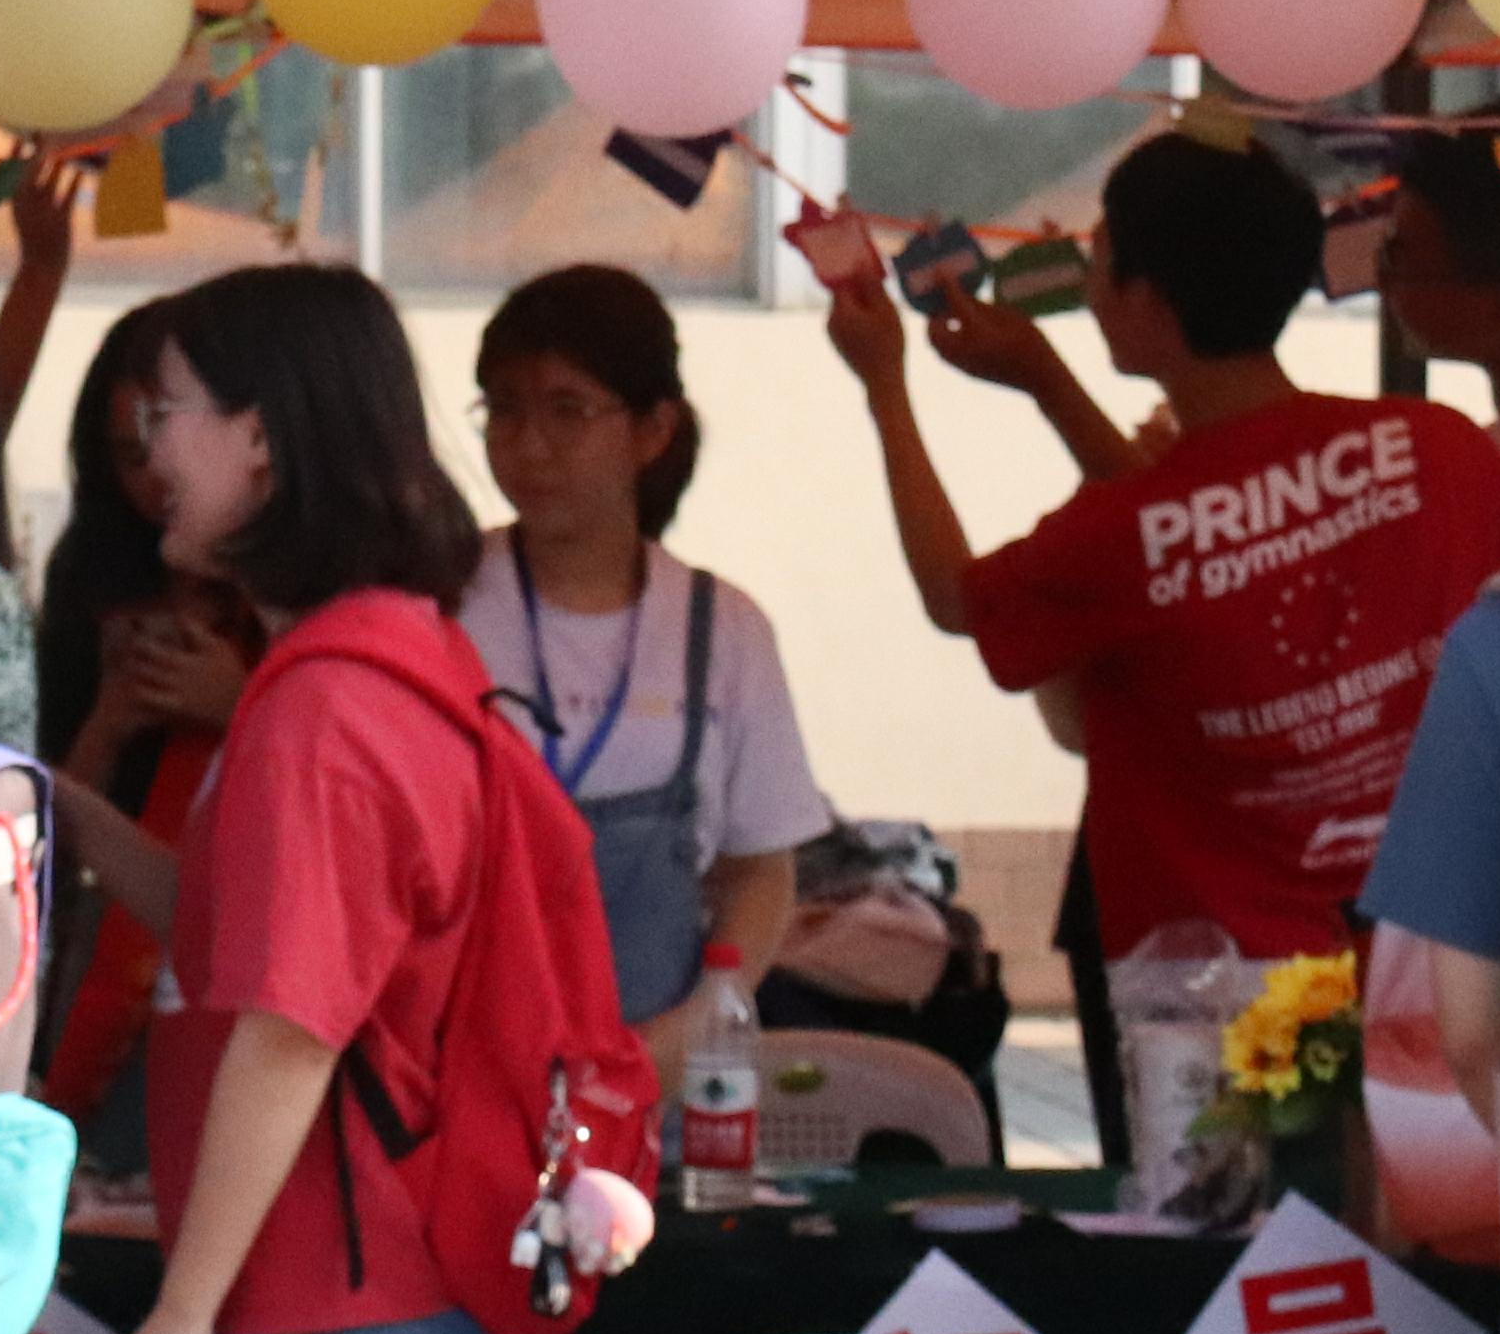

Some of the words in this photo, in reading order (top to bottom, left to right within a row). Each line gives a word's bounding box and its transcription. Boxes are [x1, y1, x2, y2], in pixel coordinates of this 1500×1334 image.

[1138, 418, 1418, 569] PRINCE
[1149, 559, 1191, 606] of
[1200, 482, 1421, 599] gymnastics
